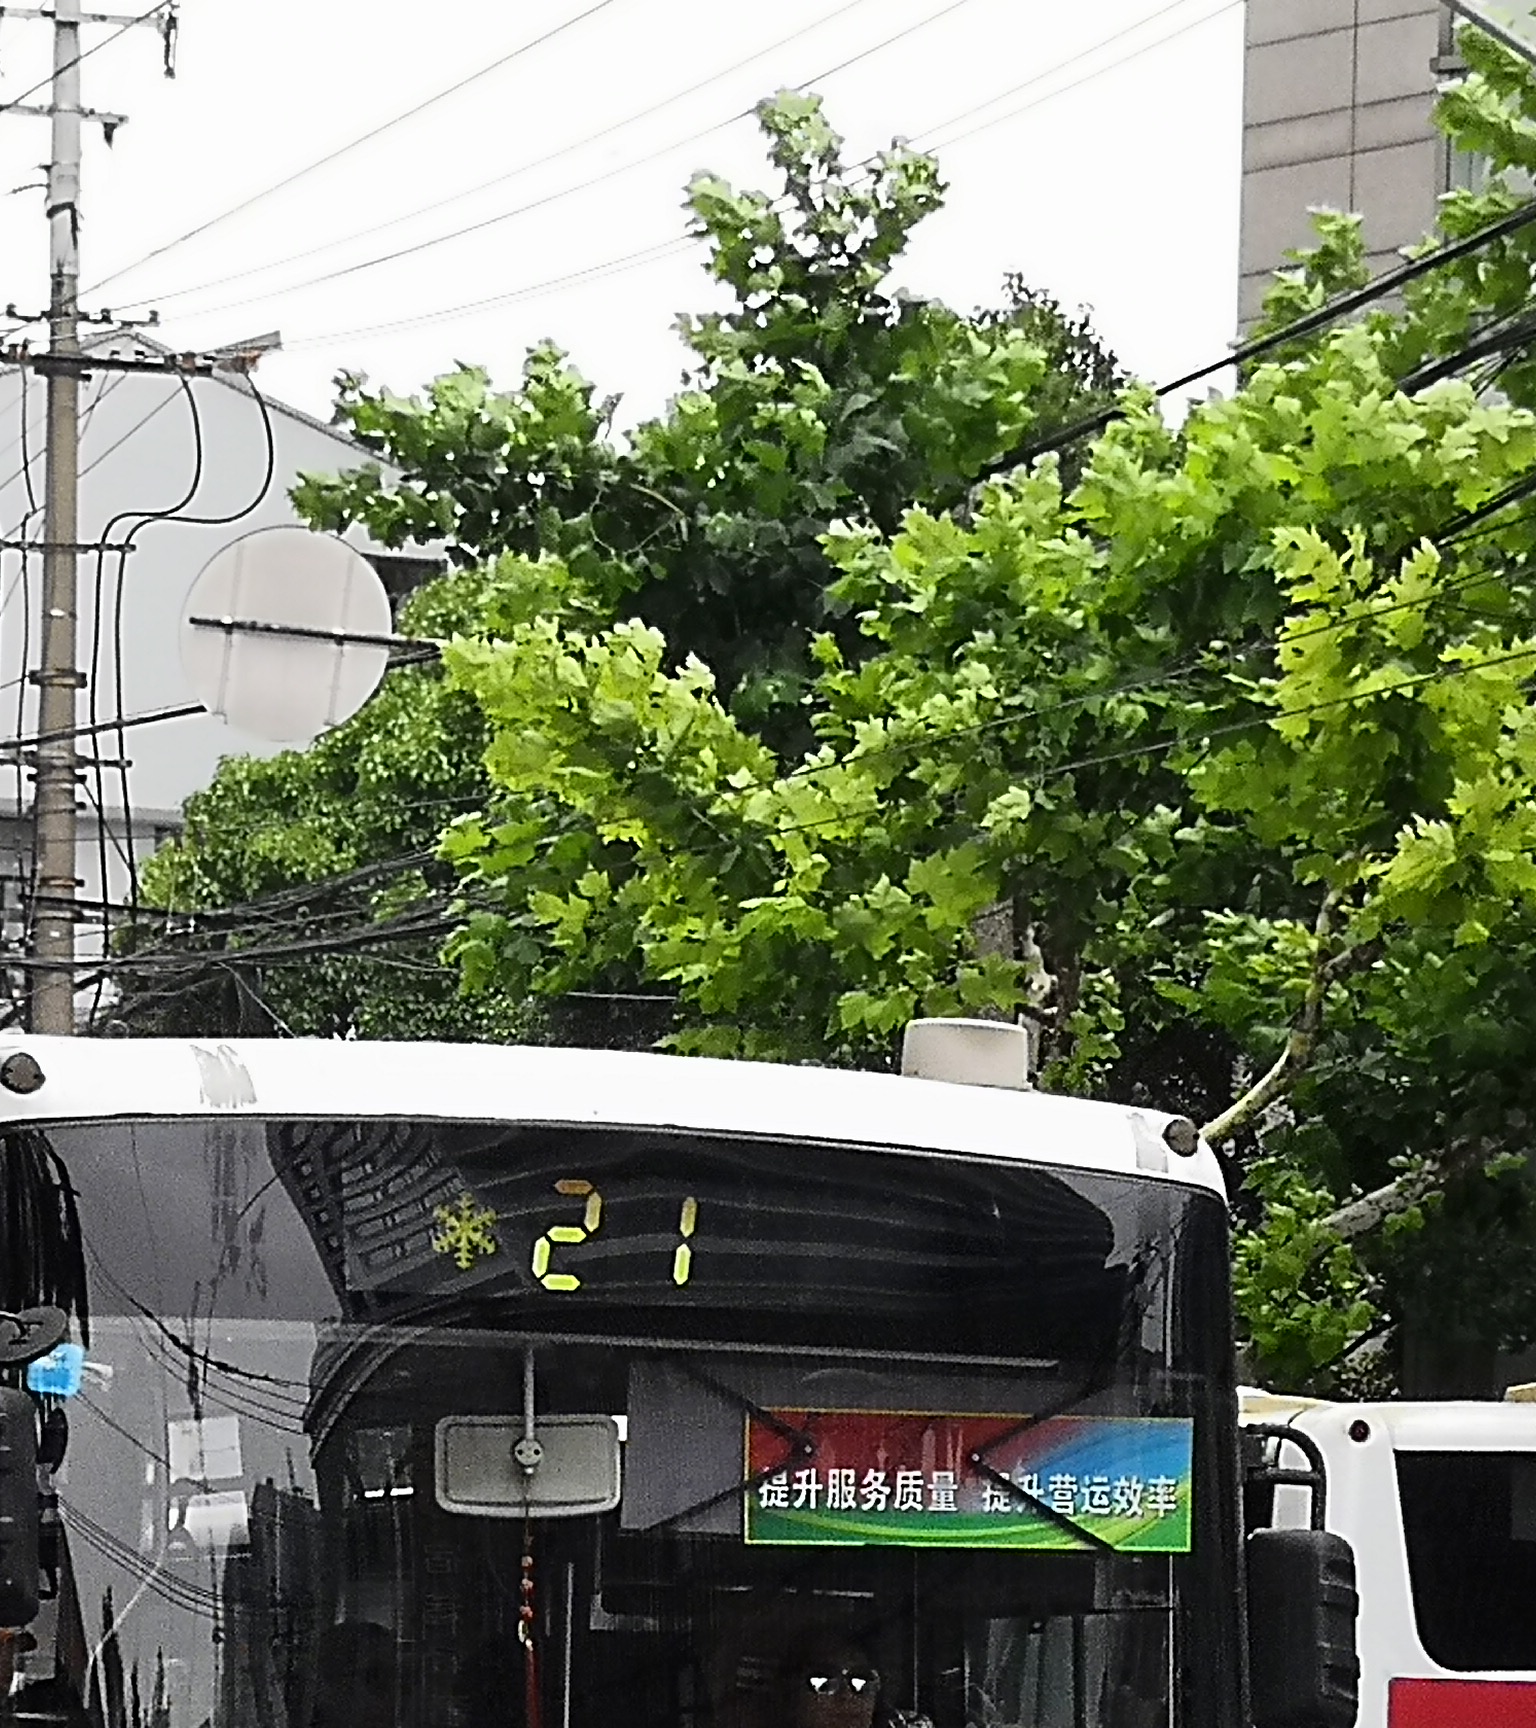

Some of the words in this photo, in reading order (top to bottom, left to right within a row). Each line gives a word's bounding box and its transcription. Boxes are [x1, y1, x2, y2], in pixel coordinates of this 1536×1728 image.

[532, 1178, 698, 1291] 21
[758, 1467, 959, 1513] 提升服务质量
